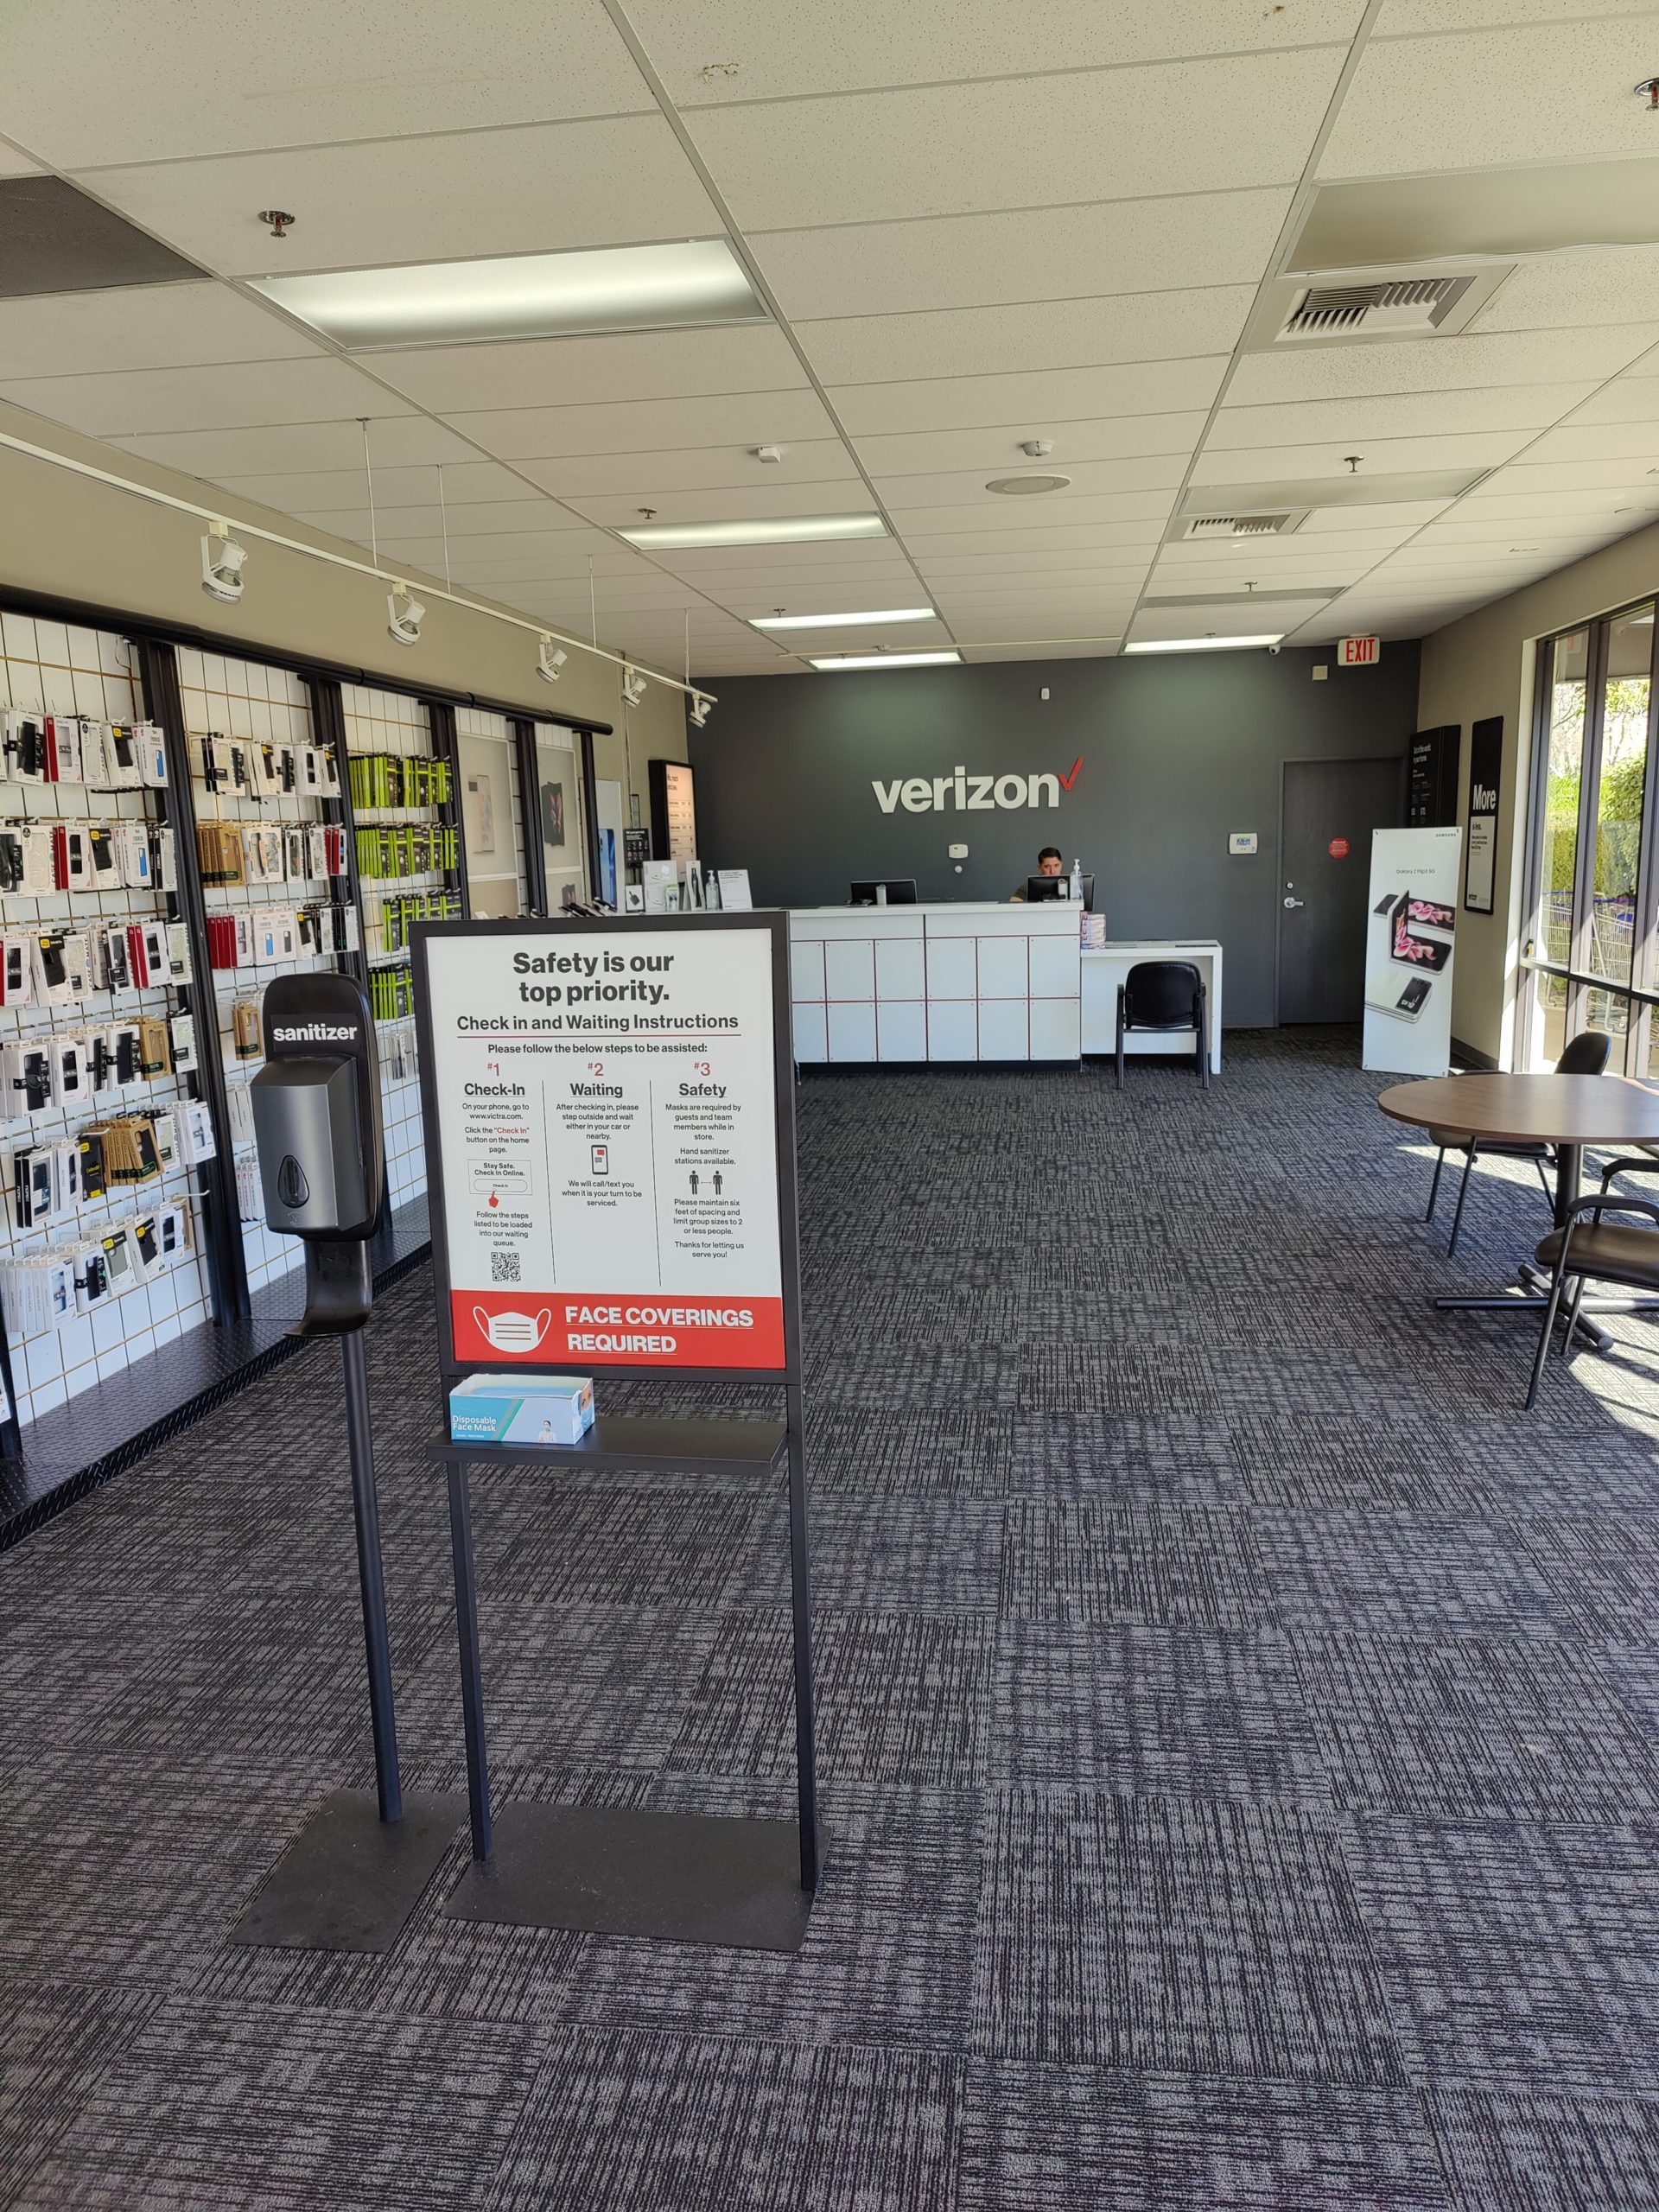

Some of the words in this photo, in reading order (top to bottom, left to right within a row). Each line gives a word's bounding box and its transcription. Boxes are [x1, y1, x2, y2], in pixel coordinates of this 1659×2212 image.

[1345, 639, 1375, 663] EXIT
[871, 766, 1059, 814] verizon
[1472, 785, 1497, 810] More
[513, 952, 599, 977] Safety
[603, 951, 625, 972] is
[630, 956, 674, 972] our
[518, 982, 562, 1007] top
[567, 979, 670, 1006] priority.
[457, 1015, 510, 1030] Check
[513, 1015, 528, 1030] in
[531, 1015, 563, 1030] and
[565, 1014, 630, 1032] Waiting
[633, 1014, 739, 1028] Instructions
[273, 1023, 358, 1041] sanitizer
[488, 1044, 521, 1053] Please
[523, 1044, 553, 1053] follow
[554, 1044, 571, 1053] the
[573, 1044, 603, 1053] below
[605, 1044, 633, 1054] steps
[634, 1044, 645, 1052] to
[646, 1043, 660, 1052] be
[661, 1043, 708, 1052] assisted:
[487, 1063, 499, 1077] #1
[588, 1062, 604, 1077] #2
[694, 1061, 710, 1077] #3
[464, 1083, 525, 1096] Check-In
[569, 1083, 623, 1098] Waiting
[679, 1083, 727, 1098] Safety
[574, 1103, 606, 1112] checking
[702, 1103, 732, 1112] required
[733, 1103, 741, 1112] by
[505, 1230, 529, 1239] waiting
[712, 1242, 734, 1250] letting
[565, 1306, 622, 1324] FACE
[626, 1308, 753, 1327] COVERINGS
[567, 1333, 677, 1353] REQUIRED
[453, 1415, 496, 1425] Disposable
[474, 1423, 496, 1432] Mask
